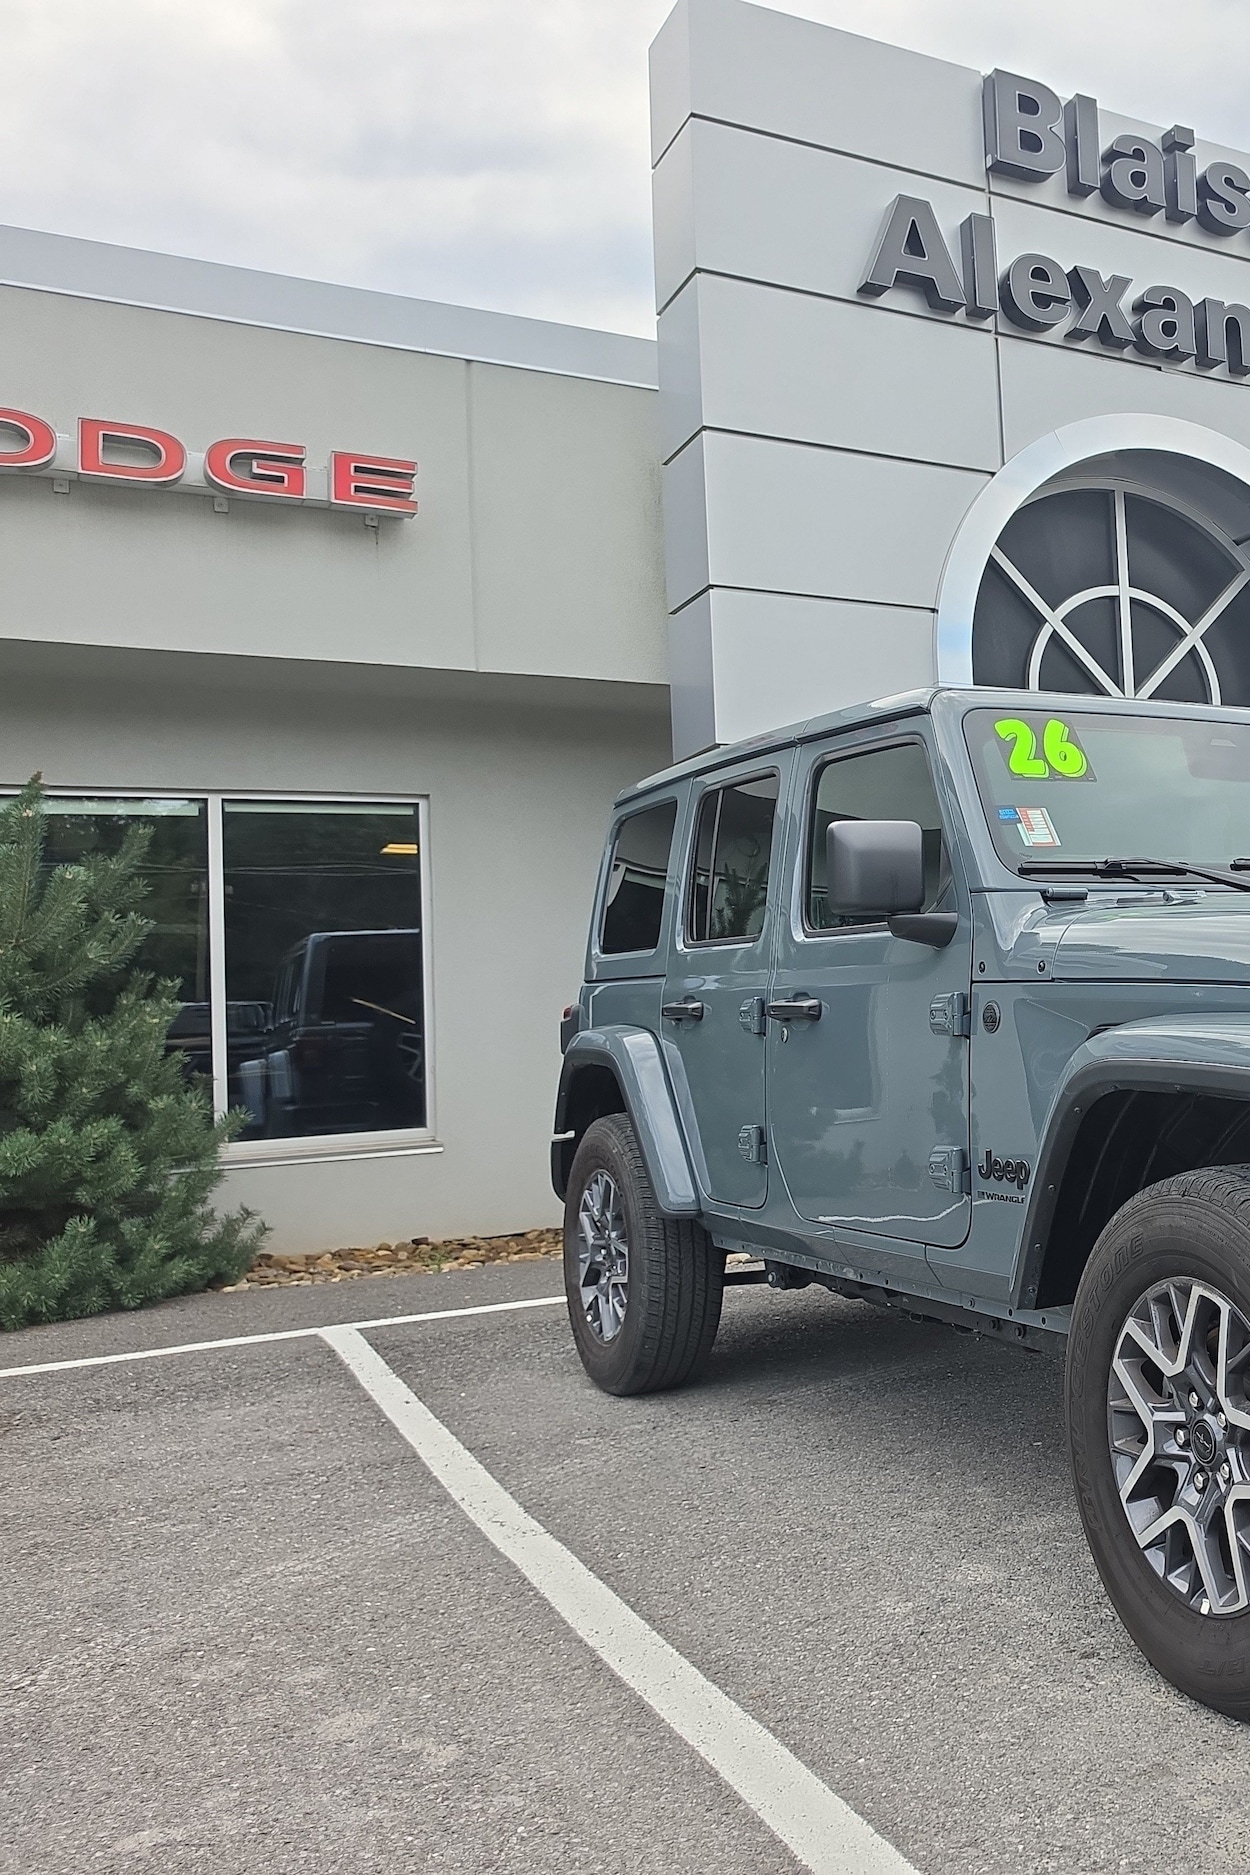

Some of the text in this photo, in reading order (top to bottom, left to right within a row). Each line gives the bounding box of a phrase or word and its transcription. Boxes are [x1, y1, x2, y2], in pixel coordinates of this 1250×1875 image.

[994, 718, 1087, 778] 26
[977, 1147, 1031, 1190] Jeep
[985, 1191, 1027, 1204] WRANGL
